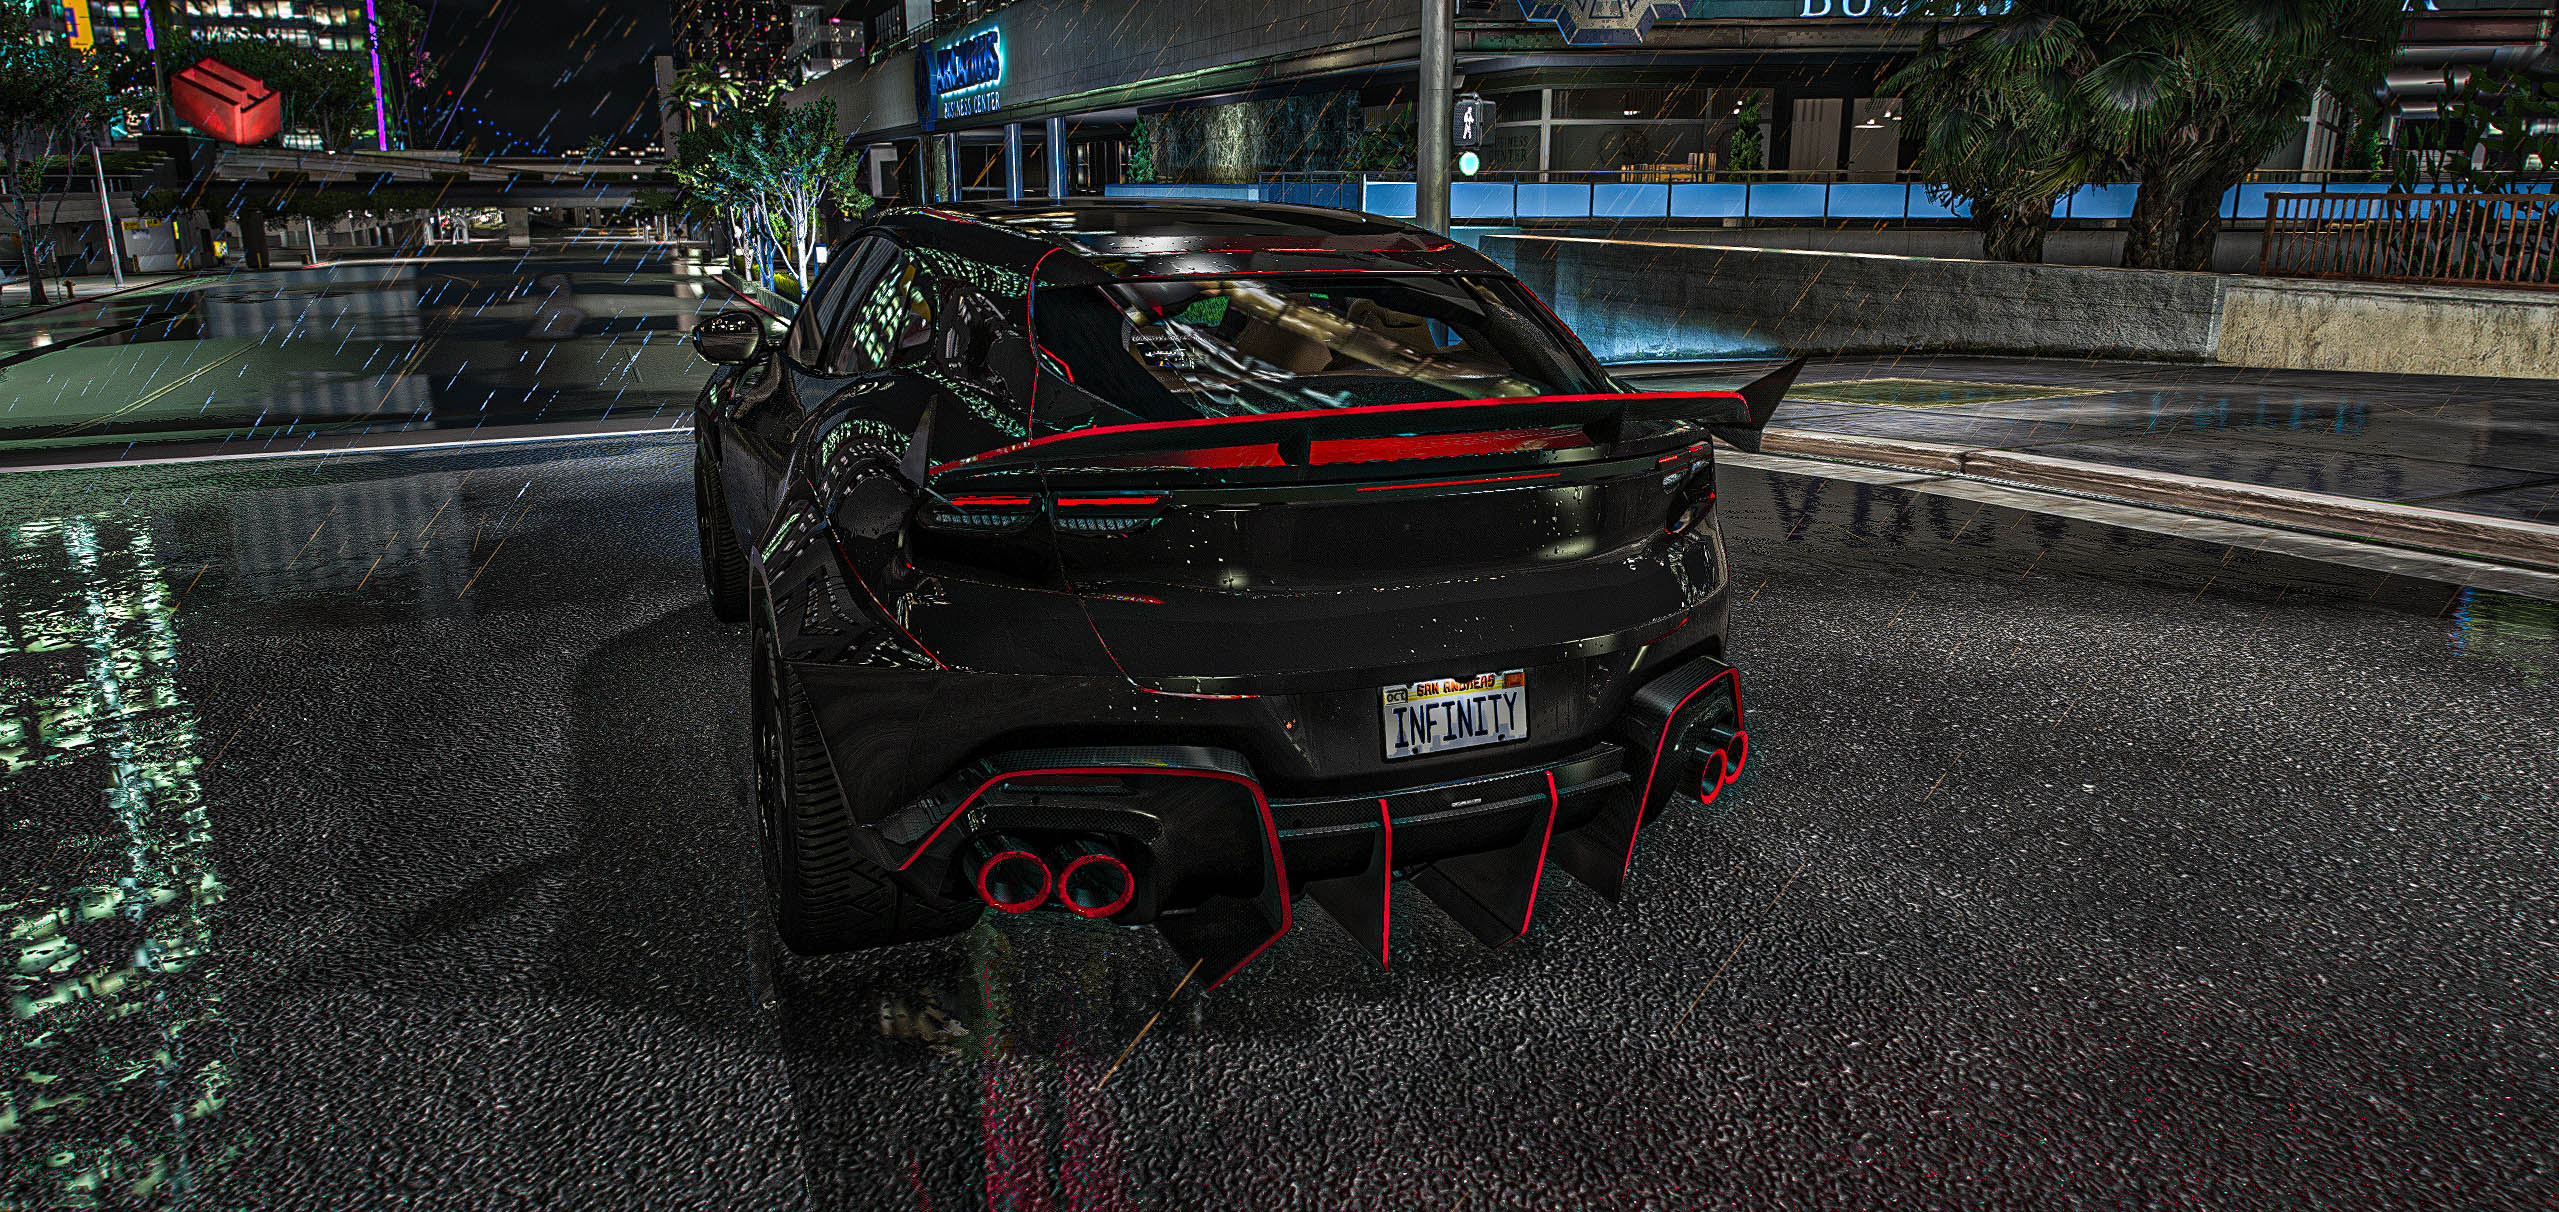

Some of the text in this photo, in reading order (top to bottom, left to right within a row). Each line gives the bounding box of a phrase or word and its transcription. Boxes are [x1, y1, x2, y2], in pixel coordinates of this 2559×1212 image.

[944, 91, 1000, 119] BUSINESS CENTER
[1416, 682, 1440, 697] SAN
[1392, 691, 1518, 749] INFINITY
